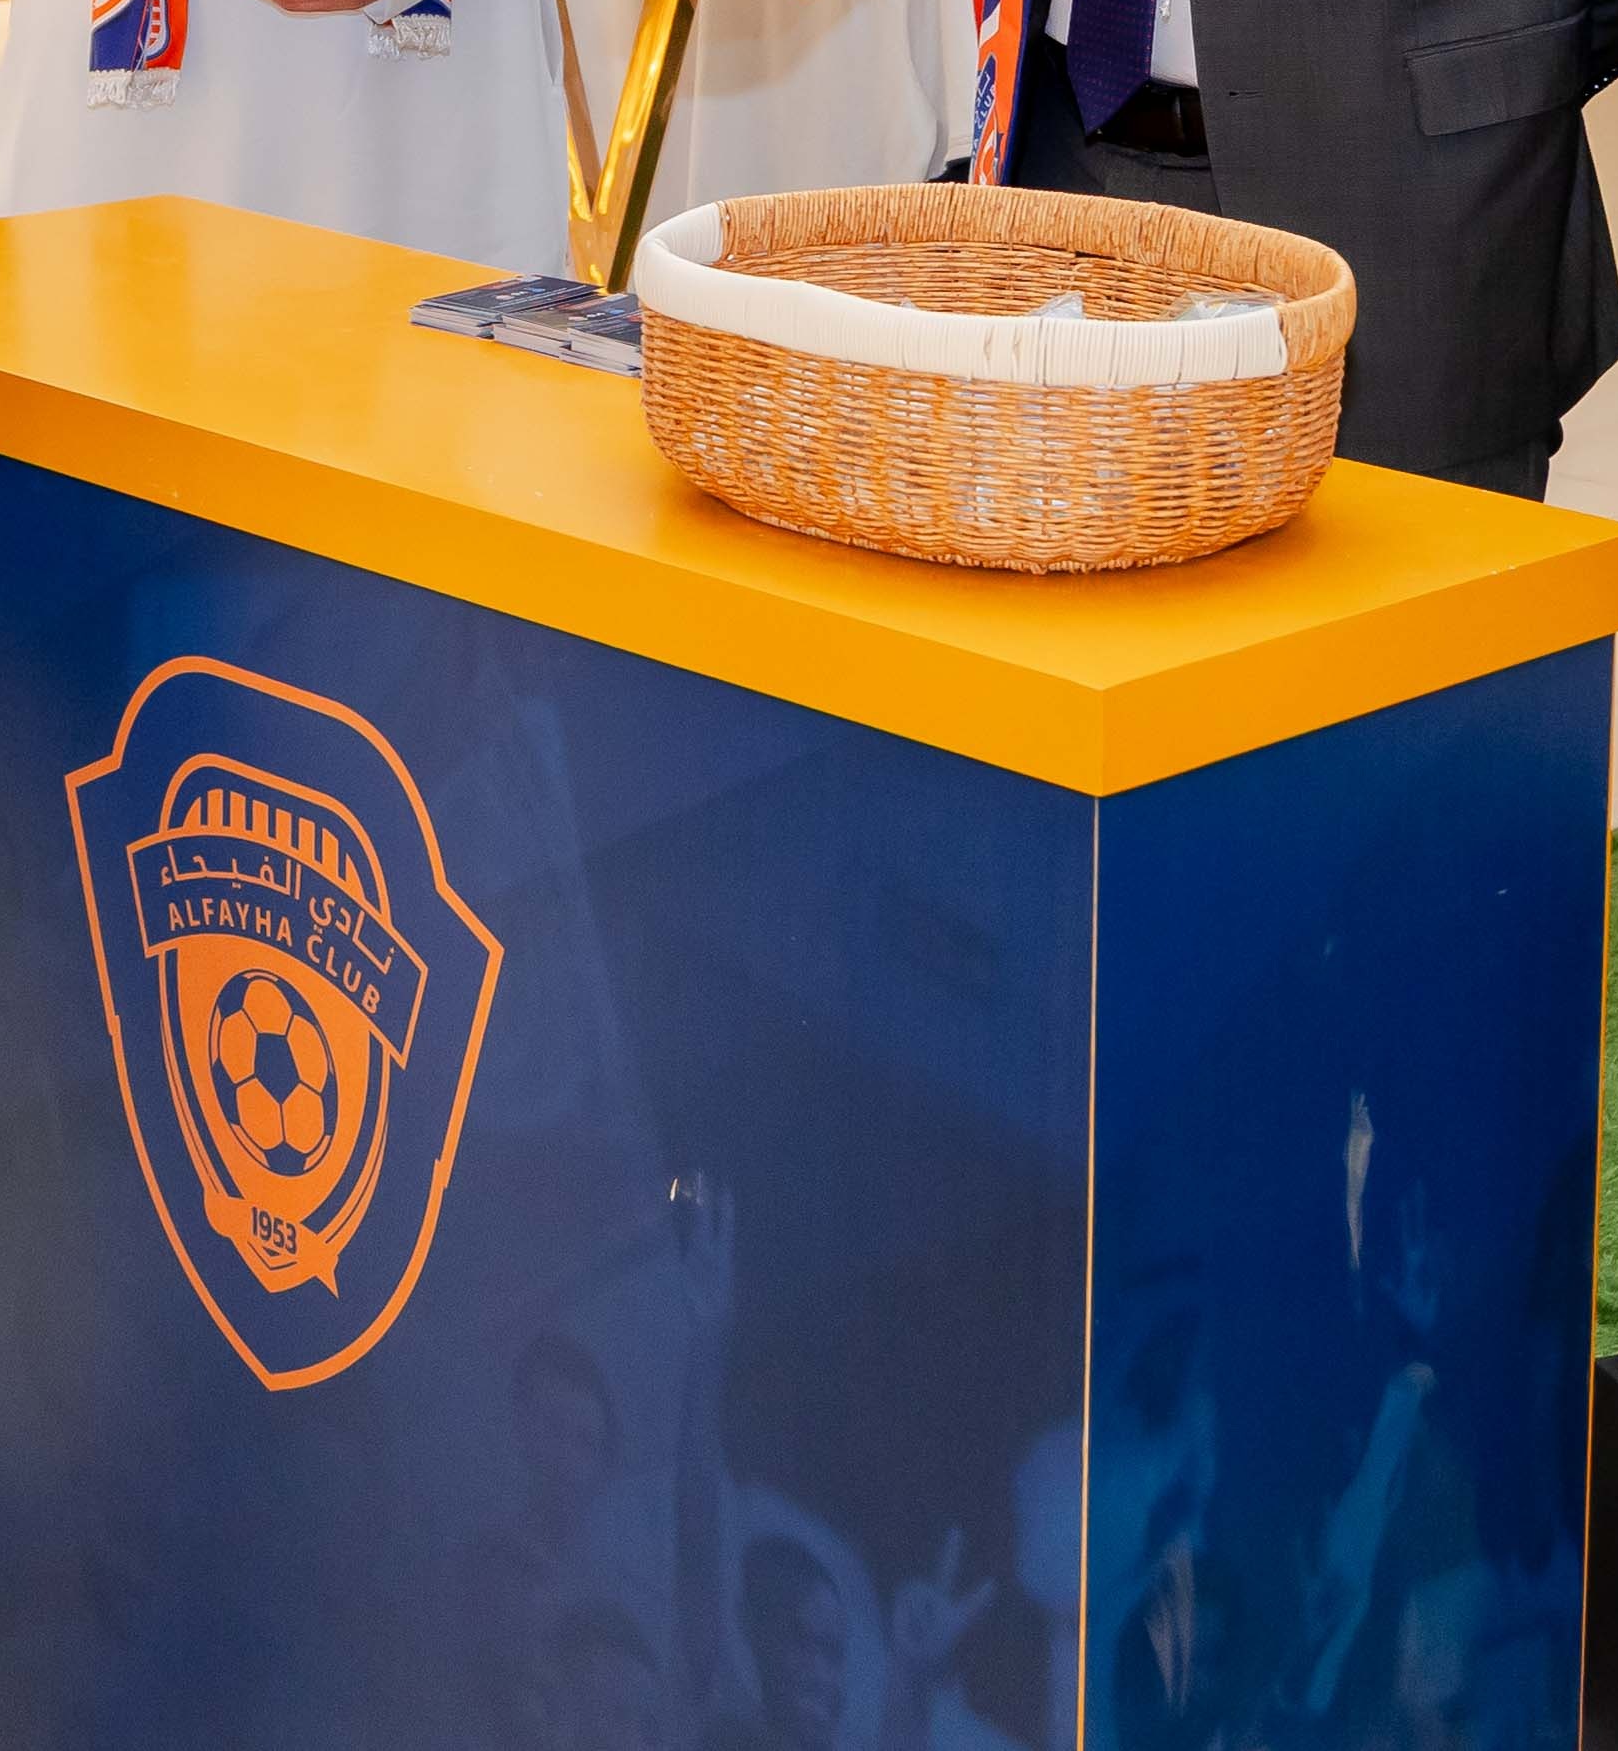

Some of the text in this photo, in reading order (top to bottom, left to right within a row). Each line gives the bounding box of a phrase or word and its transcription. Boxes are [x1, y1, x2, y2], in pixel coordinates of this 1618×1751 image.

[160, 845, 395, 975] نادي الفيحاء
[168, 897, 381, 1015] ALFAYHA CLUB
[251, 1206, 297, 1255] 1953
